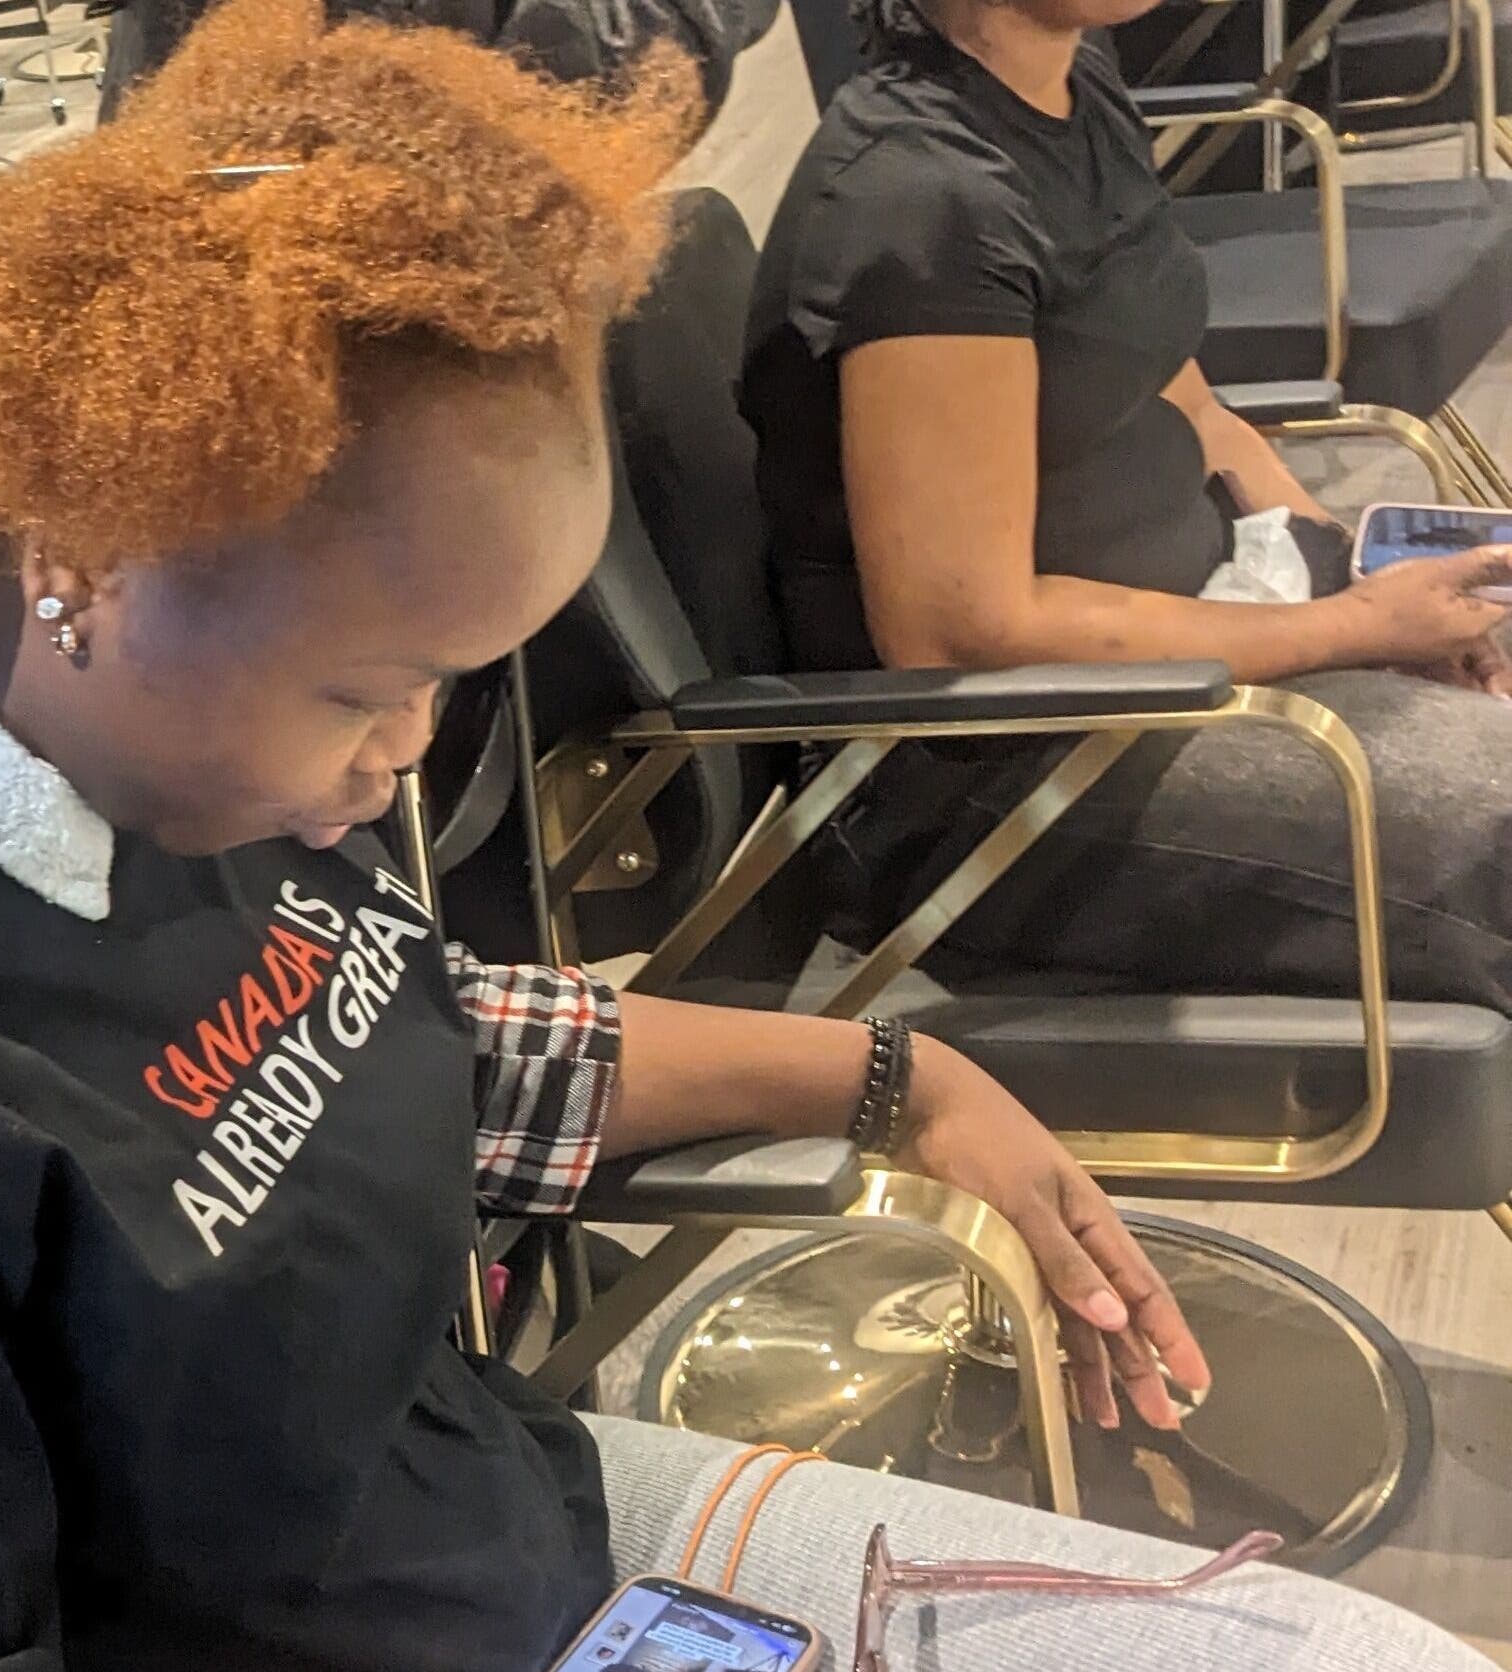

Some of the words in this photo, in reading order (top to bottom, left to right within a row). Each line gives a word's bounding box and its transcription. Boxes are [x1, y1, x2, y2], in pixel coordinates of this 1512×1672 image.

[144, 924, 334, 1119] CANADA
[273, 879, 345, 942] IS
[173, 1014, 343, 1257] ALREADY
